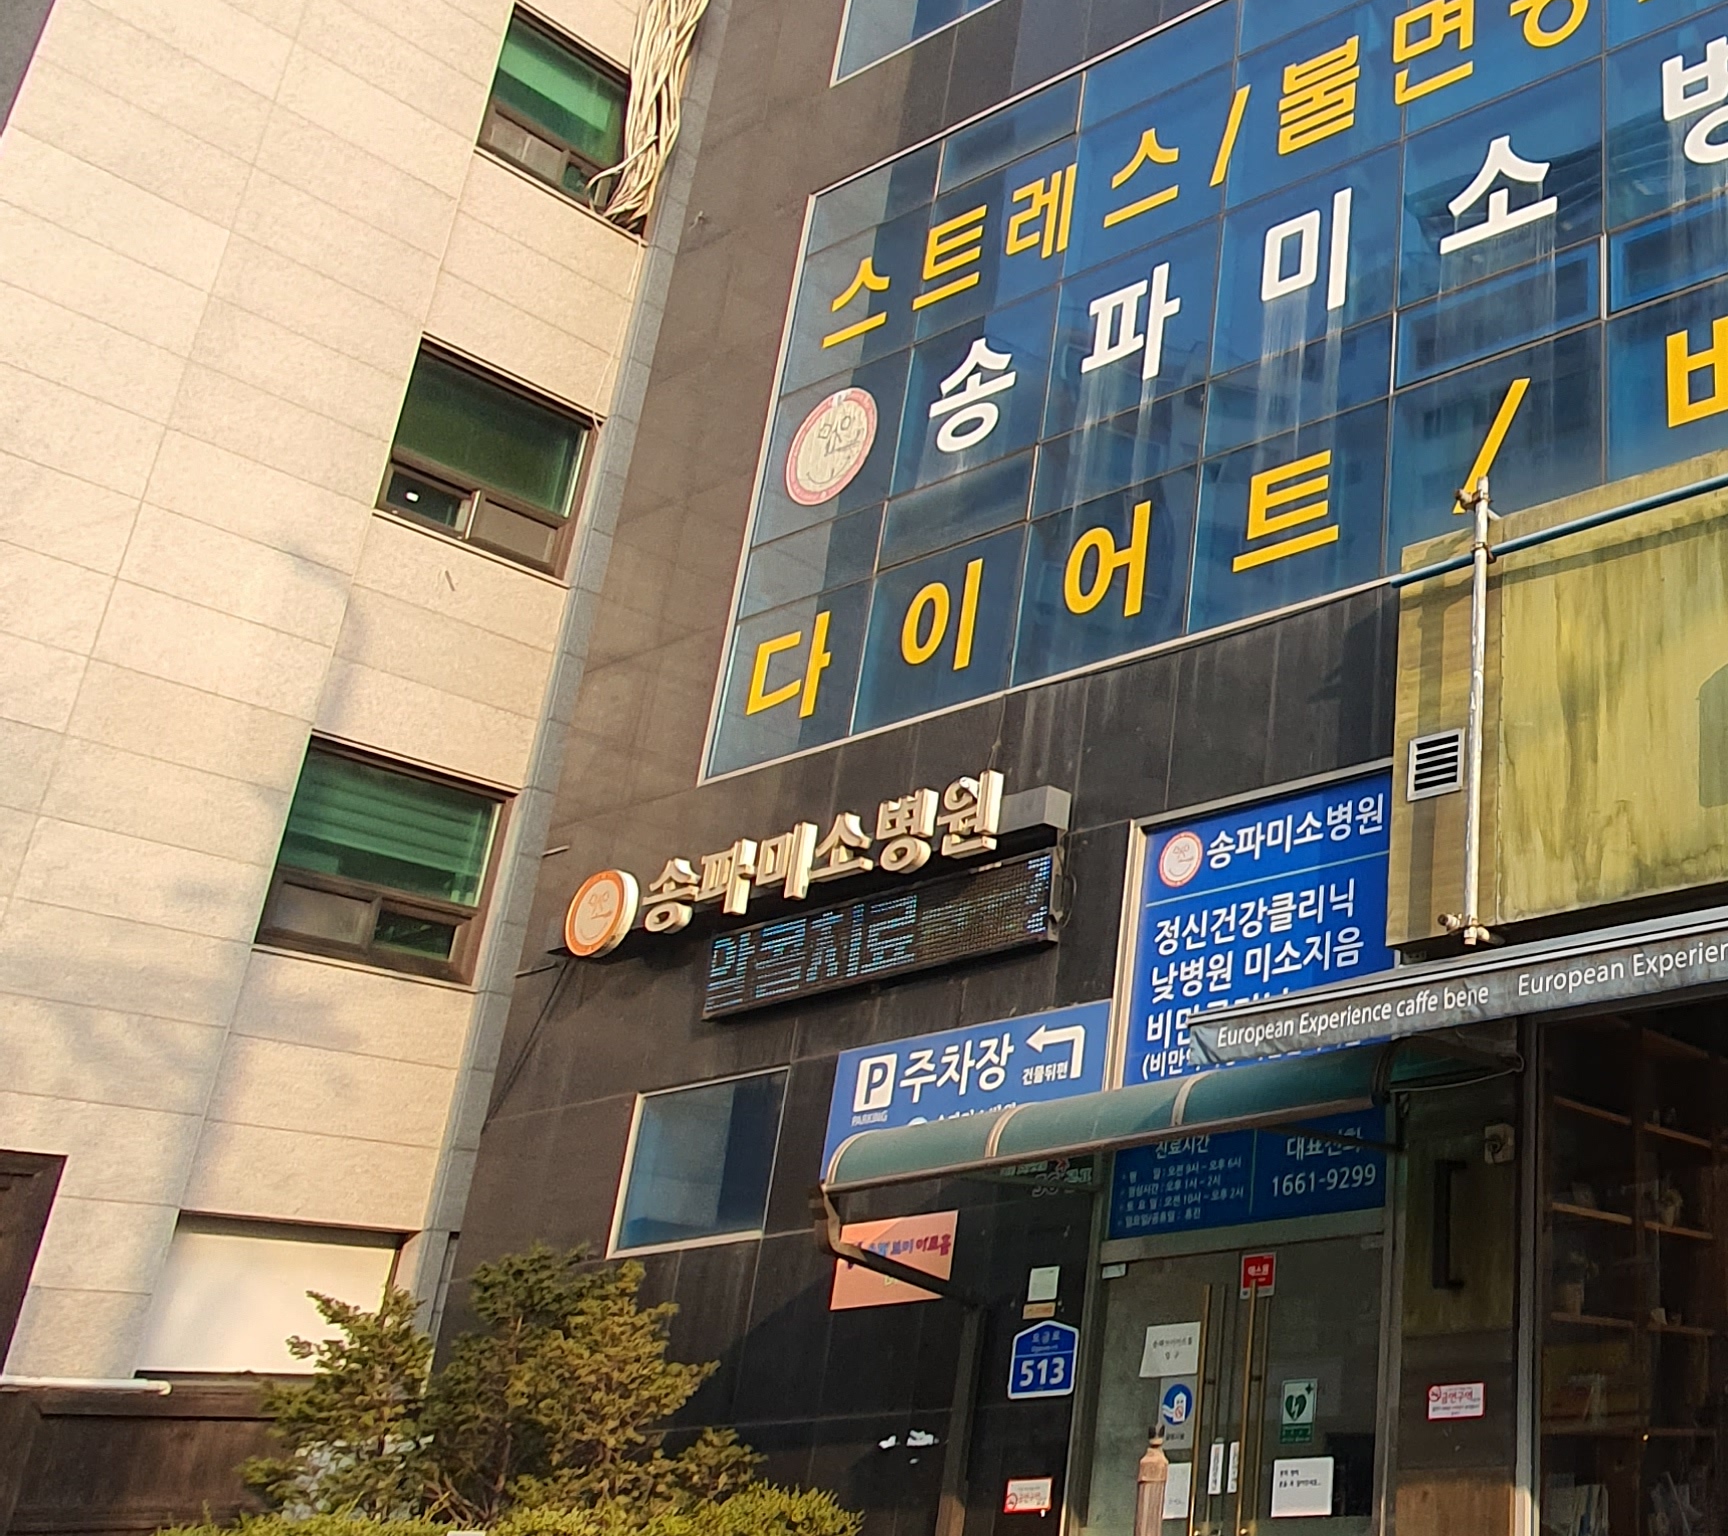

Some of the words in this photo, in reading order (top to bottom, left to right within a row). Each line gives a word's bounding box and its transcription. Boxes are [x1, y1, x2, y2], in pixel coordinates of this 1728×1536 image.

[642, 769, 1005, 934] 송파미소병원
[1206, 793, 1385, 870] 송파미소병원
[1154, 878, 1356, 957] 정신건강클리닉
[1243, 926, 1364, 984] 미소지음
[1217, 1018, 1294, 1049] European
[1299, 1001, 1394, 1039] Experience
[1396, 989, 1439, 1018] caffe
[1443, 983, 1489, 1011] bene
[1518, 962, 1625, 998] European
[899, 1032, 1015, 1105] 주차장
[1022, 1060, 1069, 1086] 건물뒤편
[1271, 1163, 1378, 1198] 1661-9299
[1018, 1356, 1066, 1388] 513
